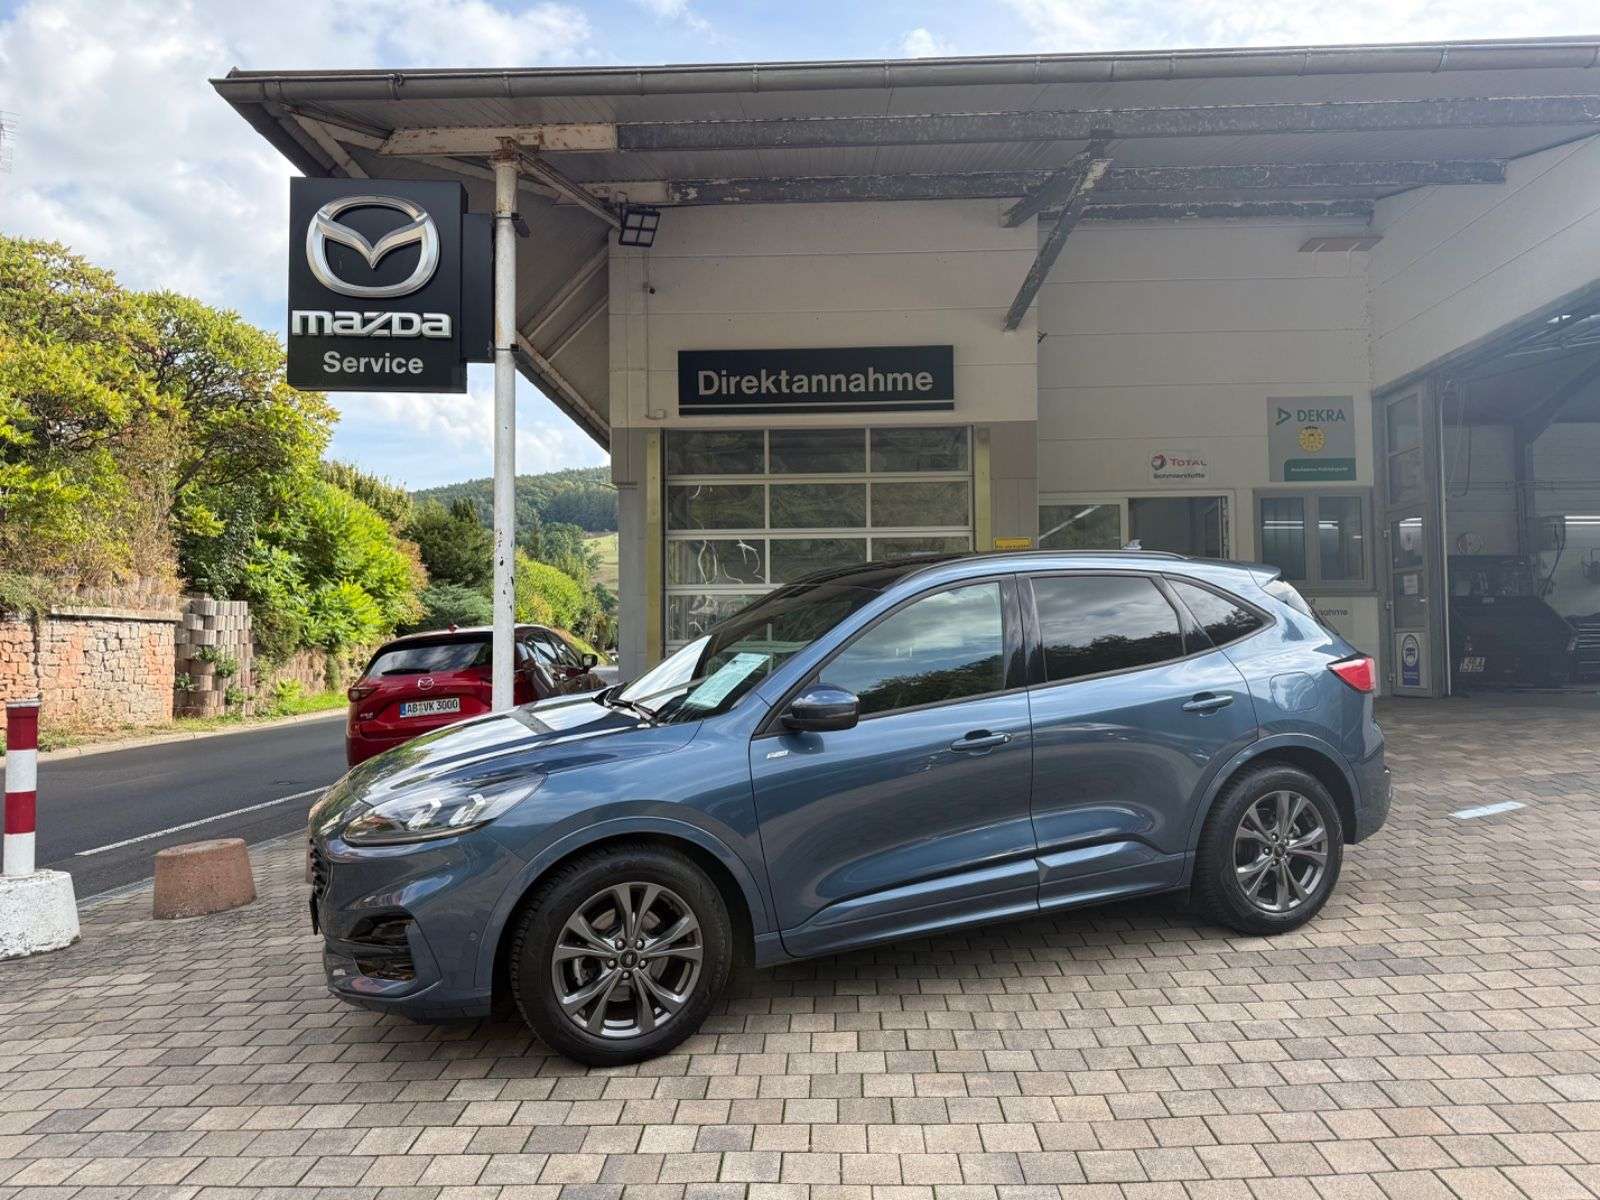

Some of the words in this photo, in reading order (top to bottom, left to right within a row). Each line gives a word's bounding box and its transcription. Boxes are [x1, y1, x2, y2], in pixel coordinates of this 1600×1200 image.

[291, 309, 452, 338] mazda
[322, 350, 424, 374] Service
[697, 367, 934, 396] Direktannahme
[1296, 409, 1346, 422] DEKRA
[1169, 457, 1207, 467] TOTAL
[437, 699, 458, 710] 3000
